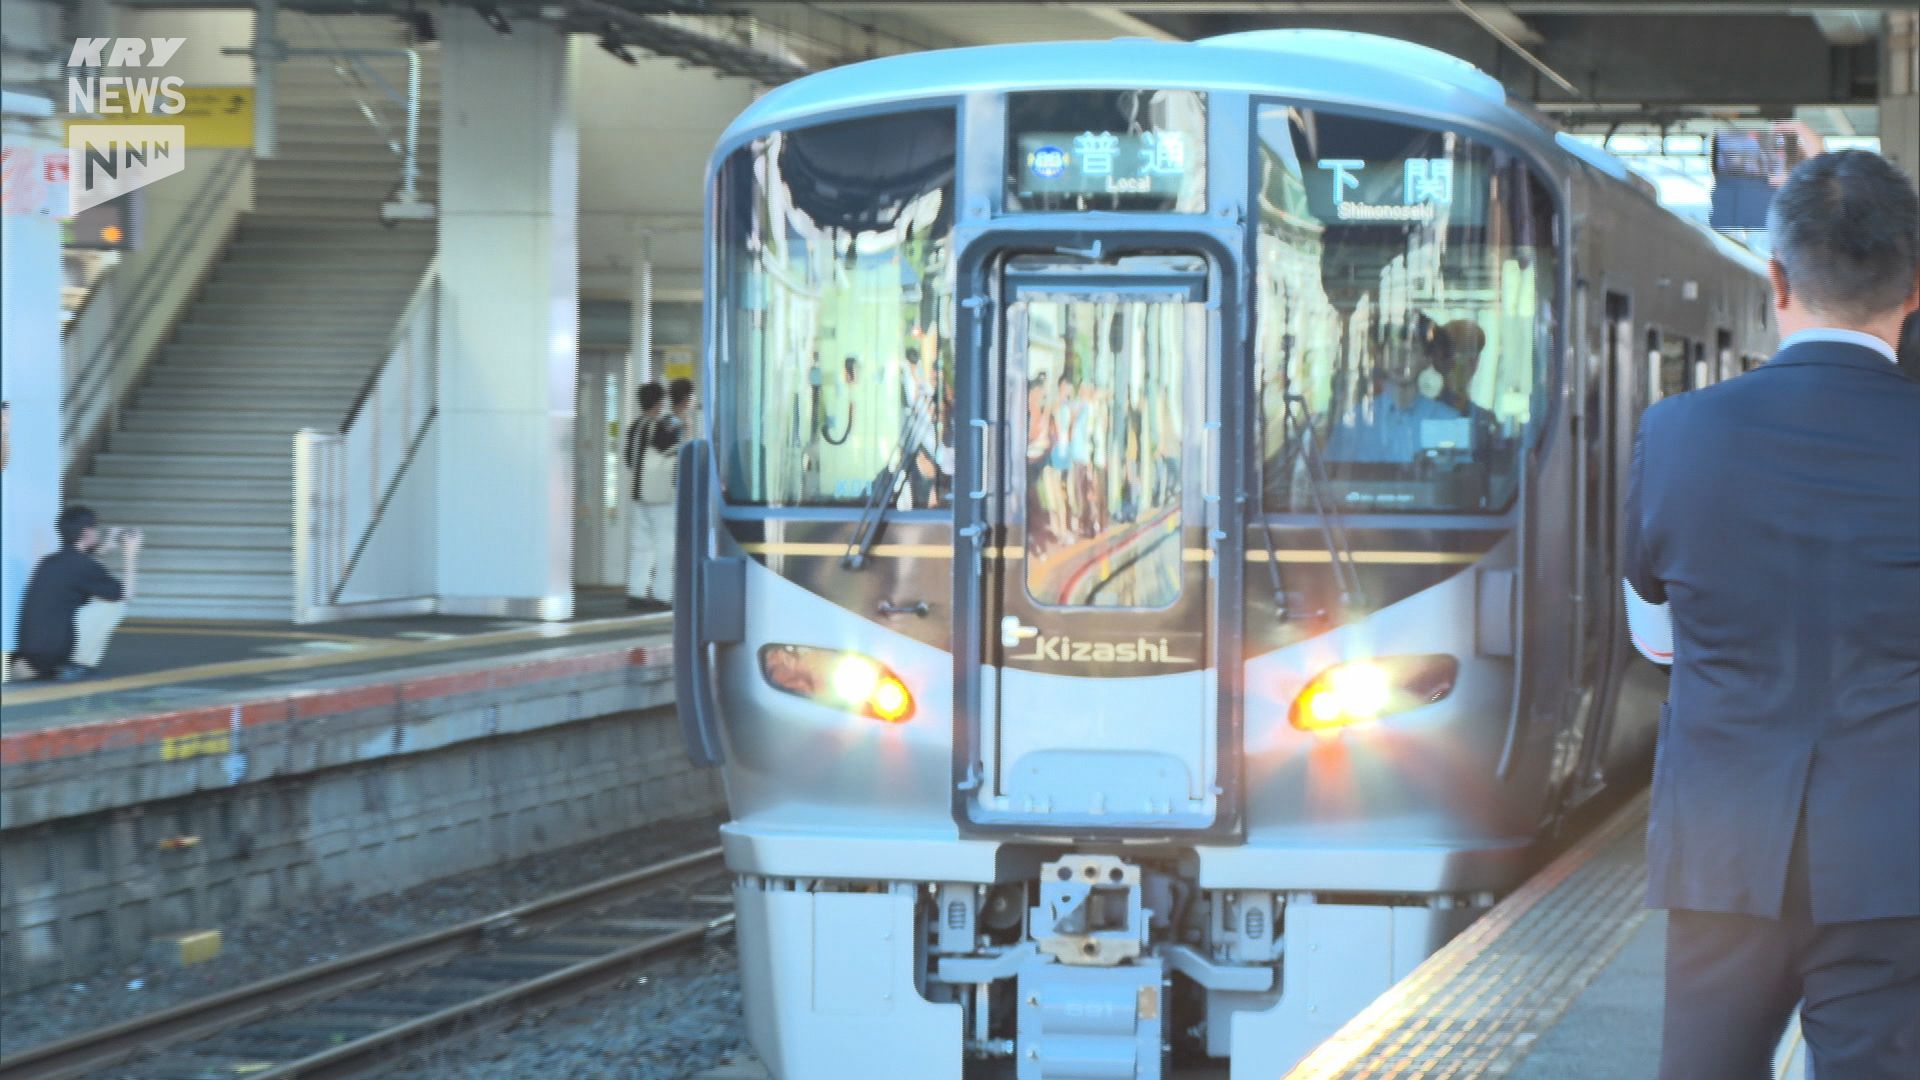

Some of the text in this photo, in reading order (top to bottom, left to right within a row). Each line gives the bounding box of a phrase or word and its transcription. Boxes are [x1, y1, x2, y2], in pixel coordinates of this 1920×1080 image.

[1073, 130, 1185, 175] 普通
[1105, 175, 1151, 193] Local
[1317, 158, 1454, 206] 下関
[1009, 635, 1196, 663] Kizashi
